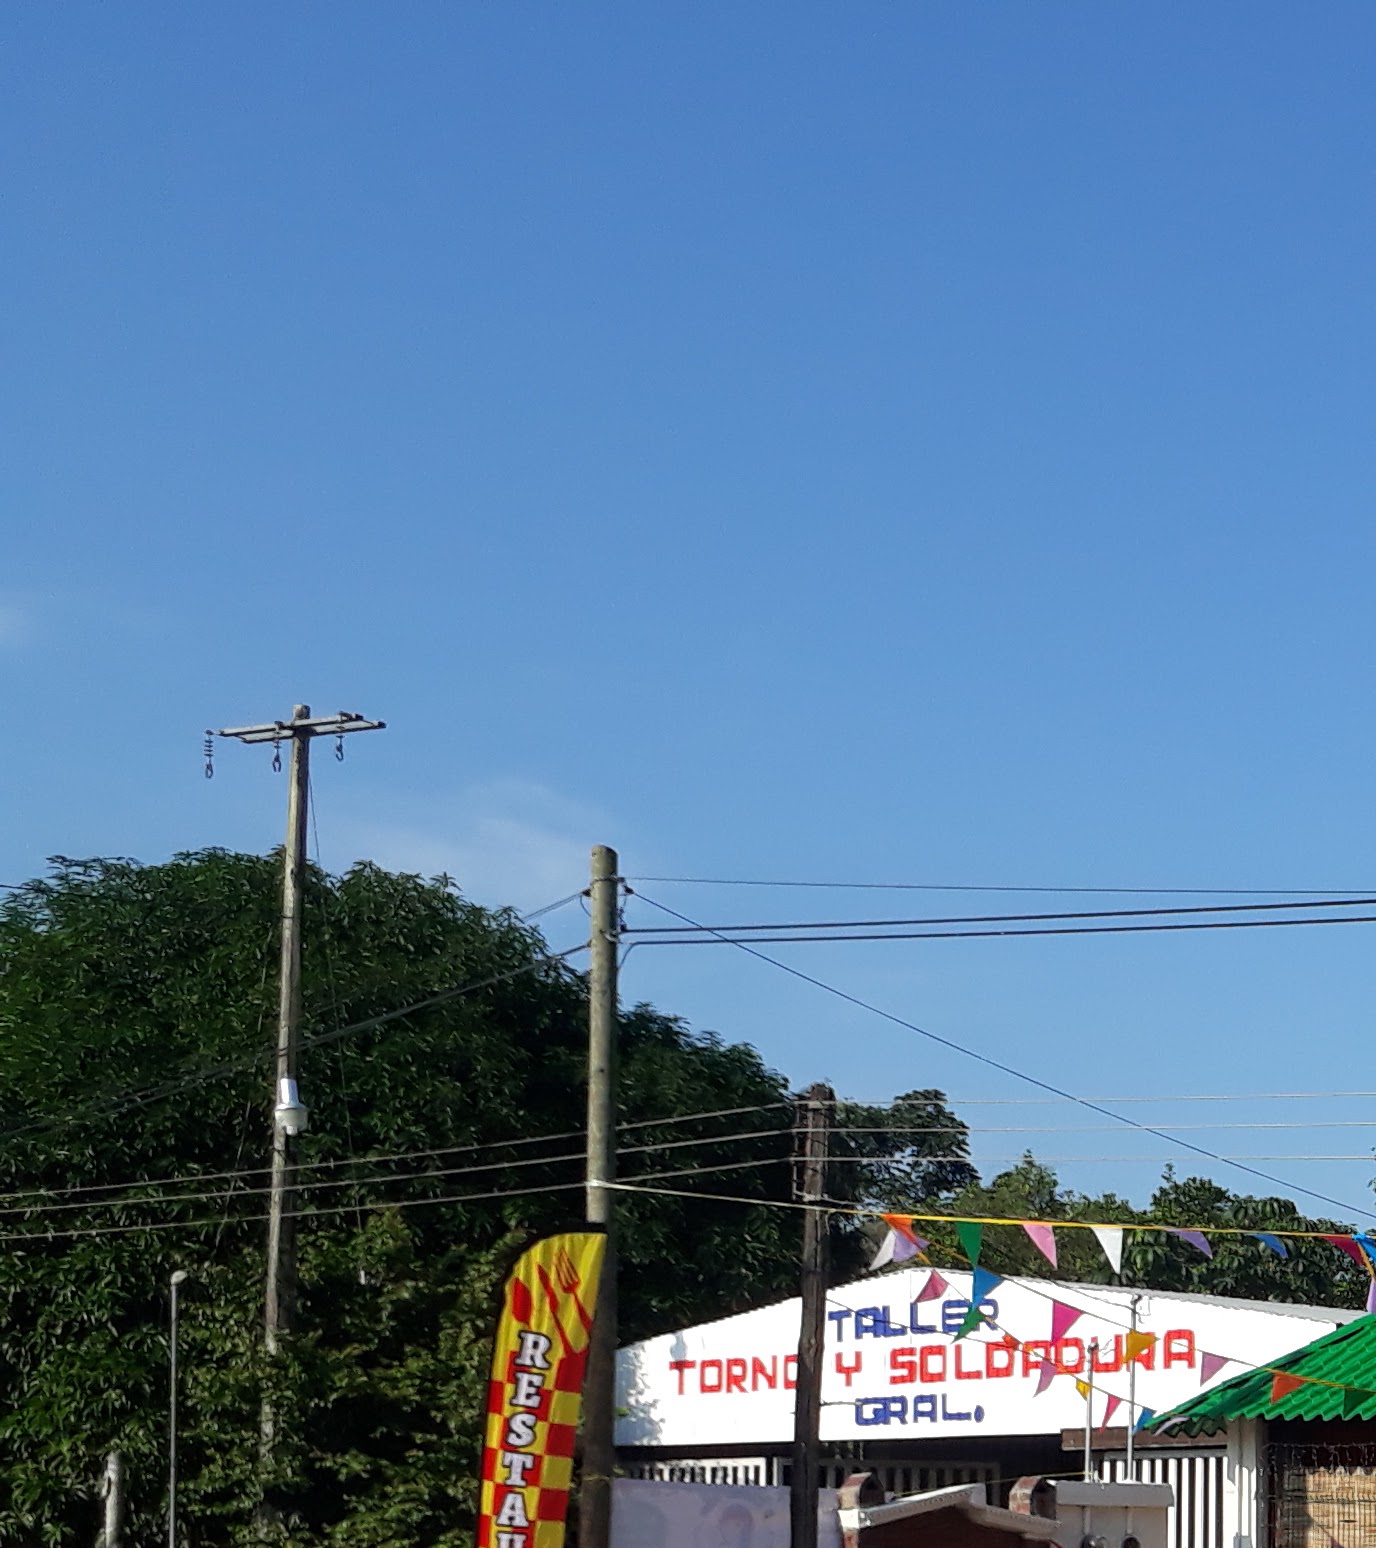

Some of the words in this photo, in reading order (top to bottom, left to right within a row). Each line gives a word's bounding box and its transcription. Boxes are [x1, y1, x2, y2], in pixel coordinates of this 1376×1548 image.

[828, 1299, 999, 1342] TALLER
[835, 1351, 863, 1387] Y
[855, 1393, 985, 1426] GRAL.
